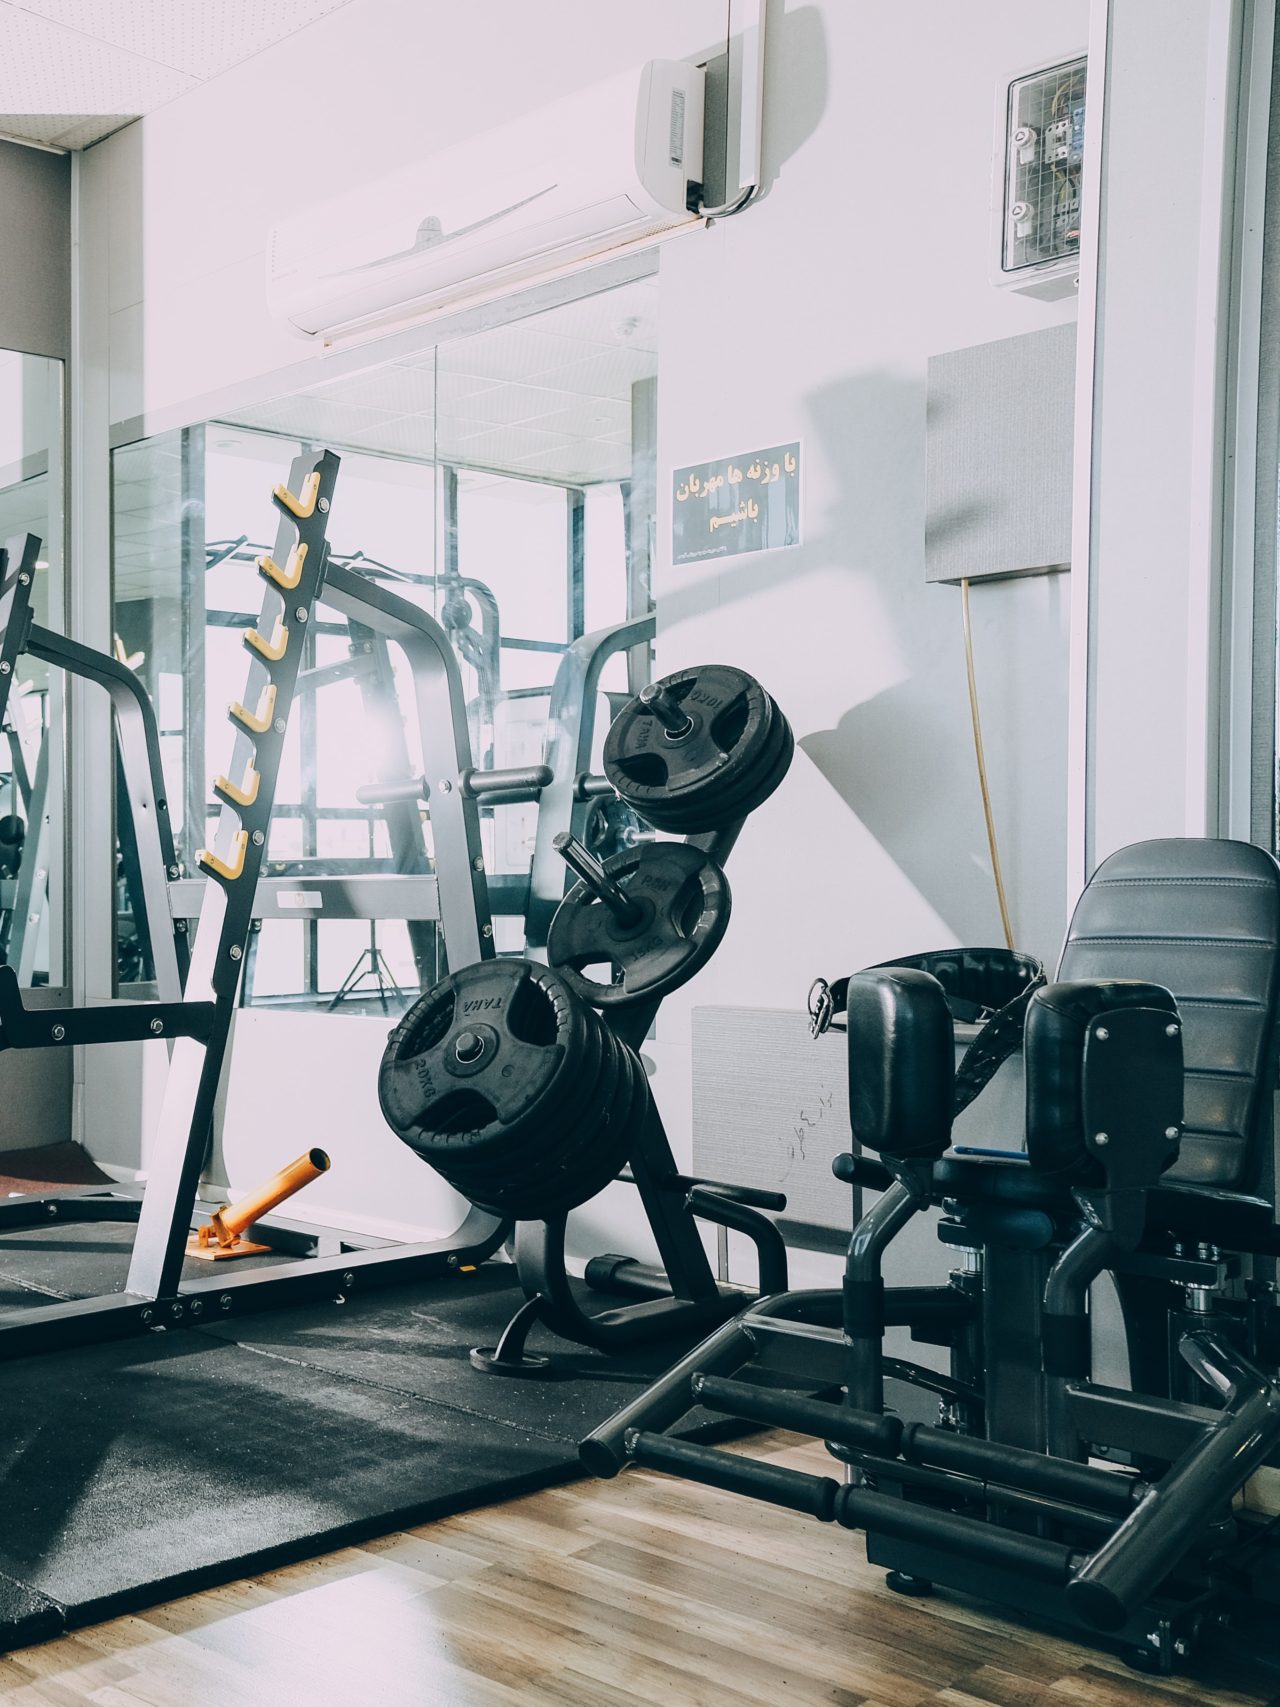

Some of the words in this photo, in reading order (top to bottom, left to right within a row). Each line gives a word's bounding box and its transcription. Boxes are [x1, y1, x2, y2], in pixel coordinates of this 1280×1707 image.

[727, 464, 743, 485] ها
[747, 459, 780, 484] وزنه
[784, 452, 796, 477] با
[676, 473, 724, 502] مهربان
[690, 691, 724, 709] 10KG
[415, 1058, 437, 1098] 20KG
